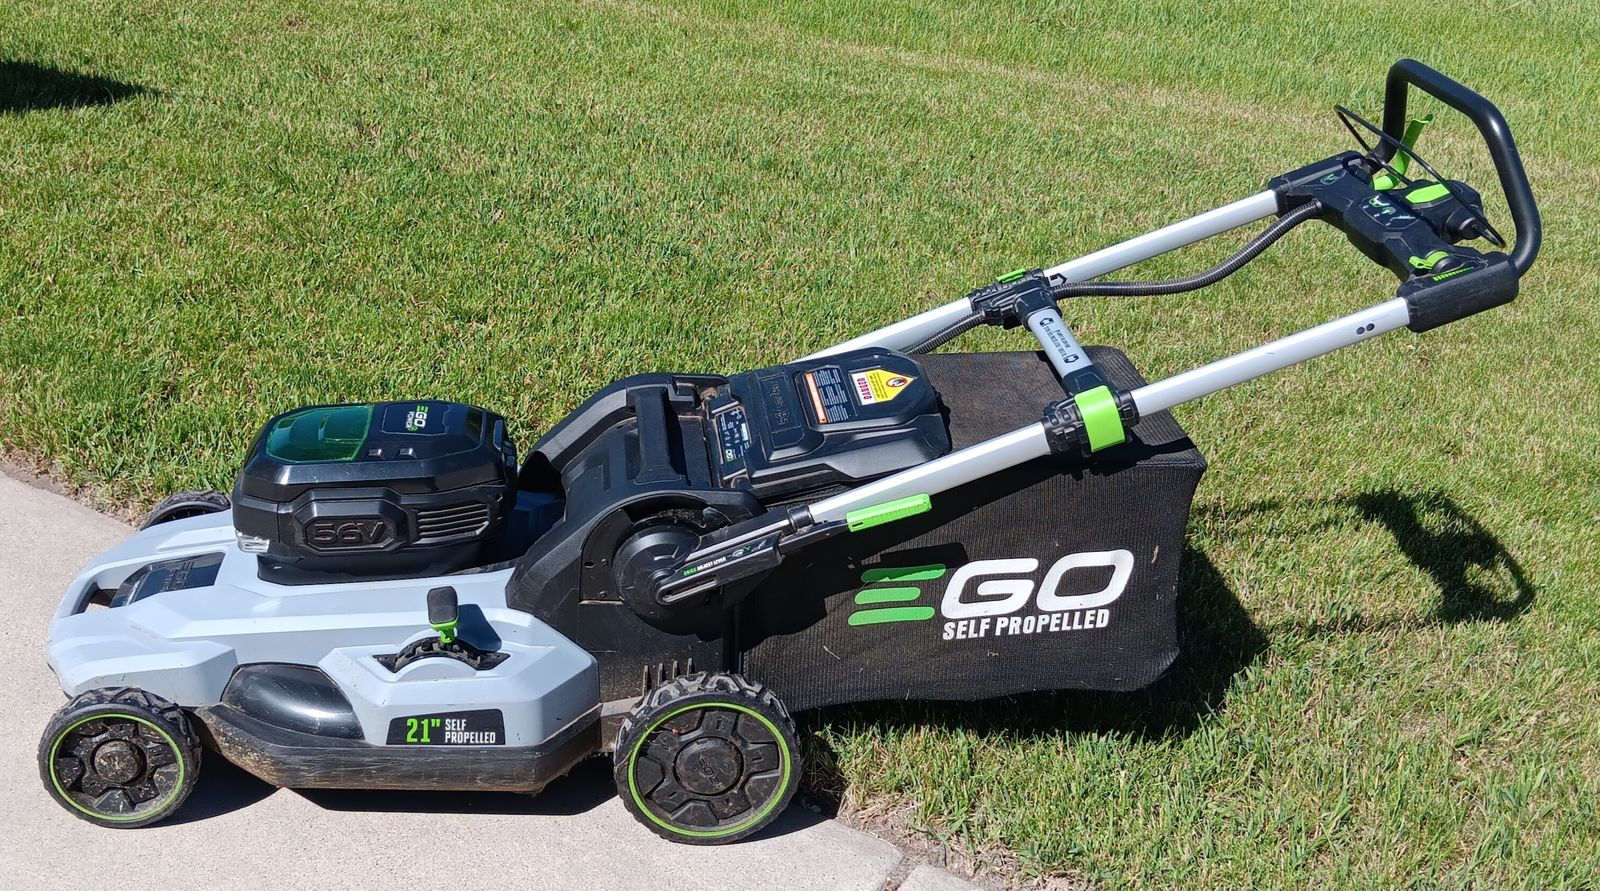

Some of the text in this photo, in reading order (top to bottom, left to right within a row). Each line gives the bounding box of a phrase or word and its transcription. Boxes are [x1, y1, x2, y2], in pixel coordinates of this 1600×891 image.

[857, 378, 872, 400] DANGER
[413, 405, 429, 429] EGO
[314, 522, 384, 543] 56V
[848, 549, 1134, 625] EGO
[942, 608, 1110, 640] SELF PROPELLED
[406, 718, 441, 743] 21"
[444, 719, 467, 731] SELF
[444, 731, 496, 744] PROPELLED
